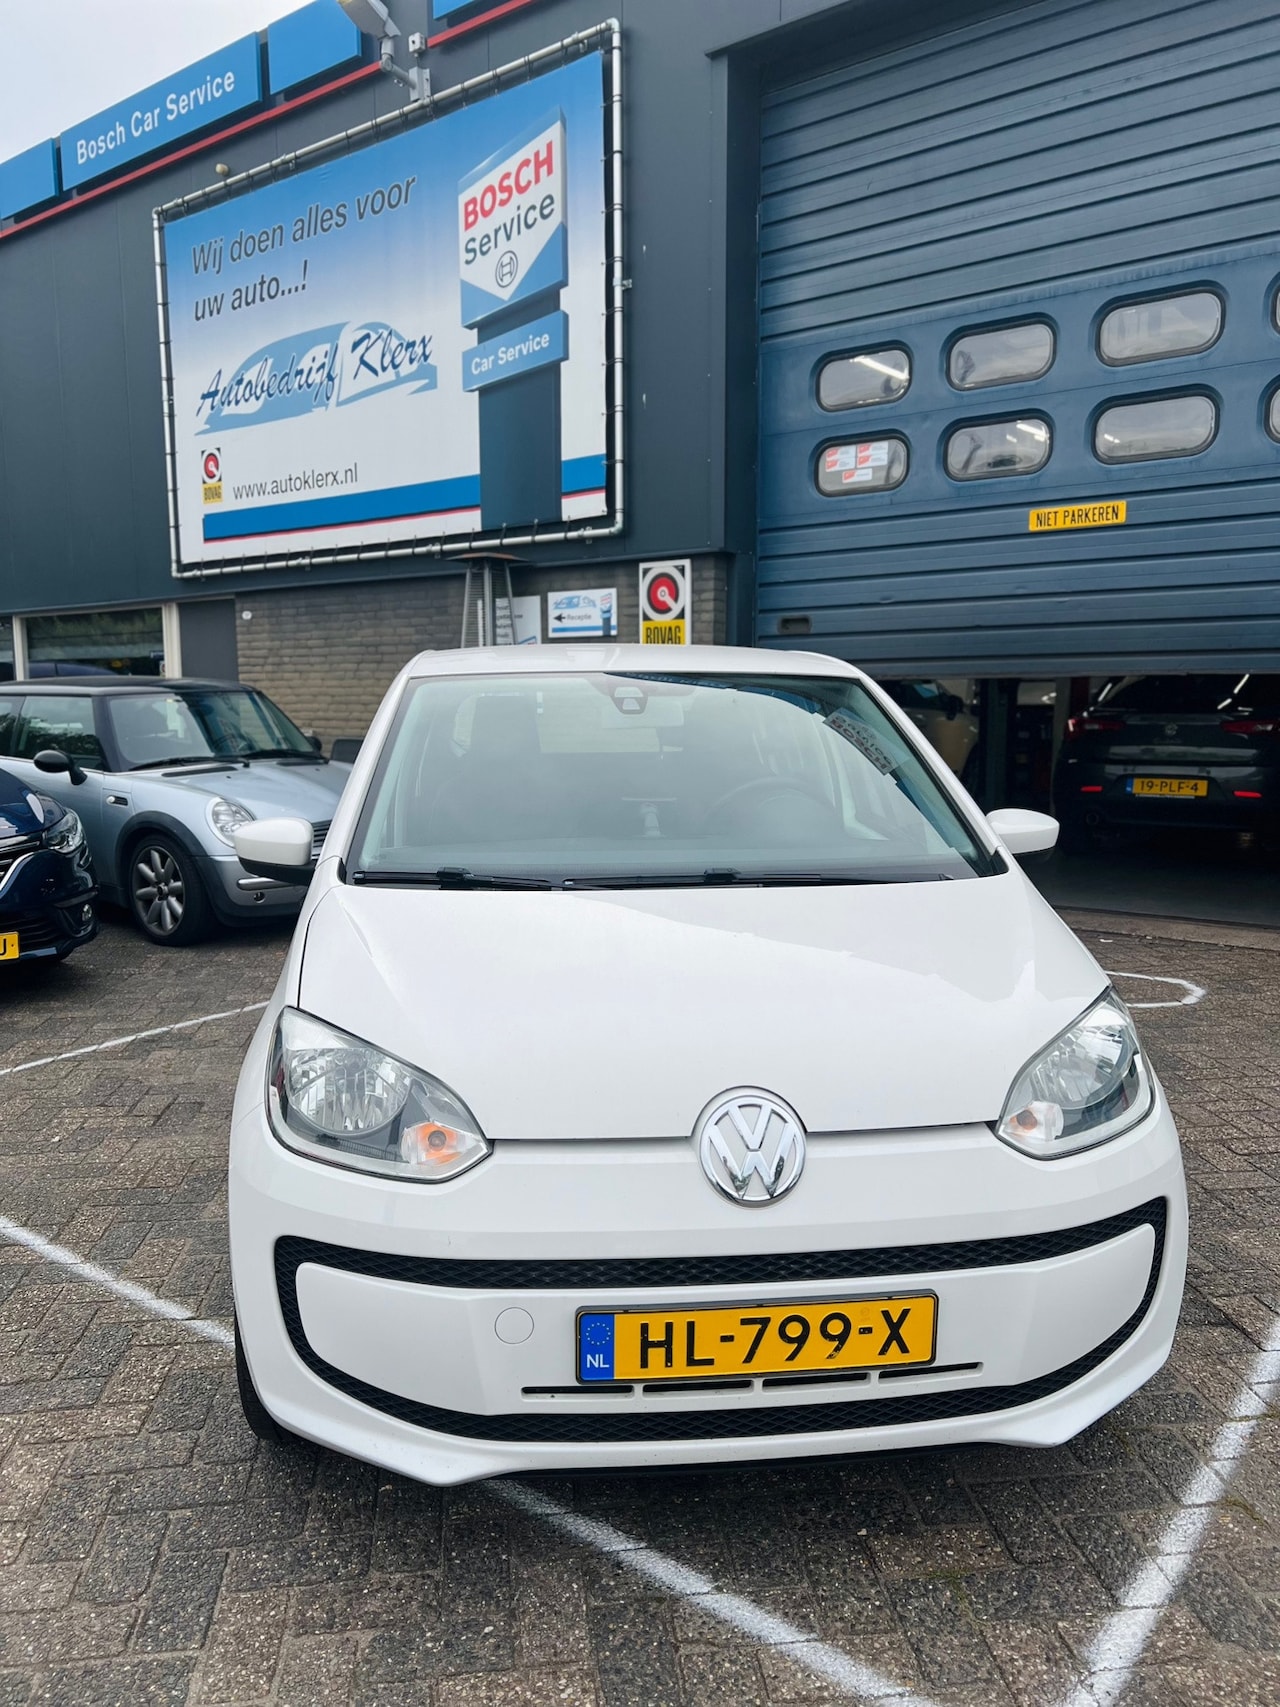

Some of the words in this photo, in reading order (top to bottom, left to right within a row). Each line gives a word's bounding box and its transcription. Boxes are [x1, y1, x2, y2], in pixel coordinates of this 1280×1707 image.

[76, 121, 126, 165] Bosch
[131, 107, 160, 137] Car
[166, 71, 235, 121] Service
[464, 140, 554, 231] BOSCH
[192, 238, 224, 275] Wij
[230, 224, 284, 262] doen
[292, 202, 347, 242] alles
[356, 177, 416, 220] voor
[464, 194, 555, 265] Service
[194, 293, 224, 321] uw
[231, 259, 308, 311] auto...!
[196, 342, 338, 416] Autobedrijf
[351, 328, 433, 380] Klerx
[471, 356, 494, 375] Car
[498, 333, 550, 365] Service
[204, 485, 222, 501] BOVAG
[233, 463, 358, 499] www.autoklerx.nl
[1036, 511, 1059, 528] NIET
[1063, 505, 1119, 525] PARKEREN
[646, 625, 681, 644] BOVAG
[1140, 780, 1199, 793] 19-PLF-4
[586, 1353, 610, 1369] NL
[639, 1307, 912, 1369] HL-799-X
